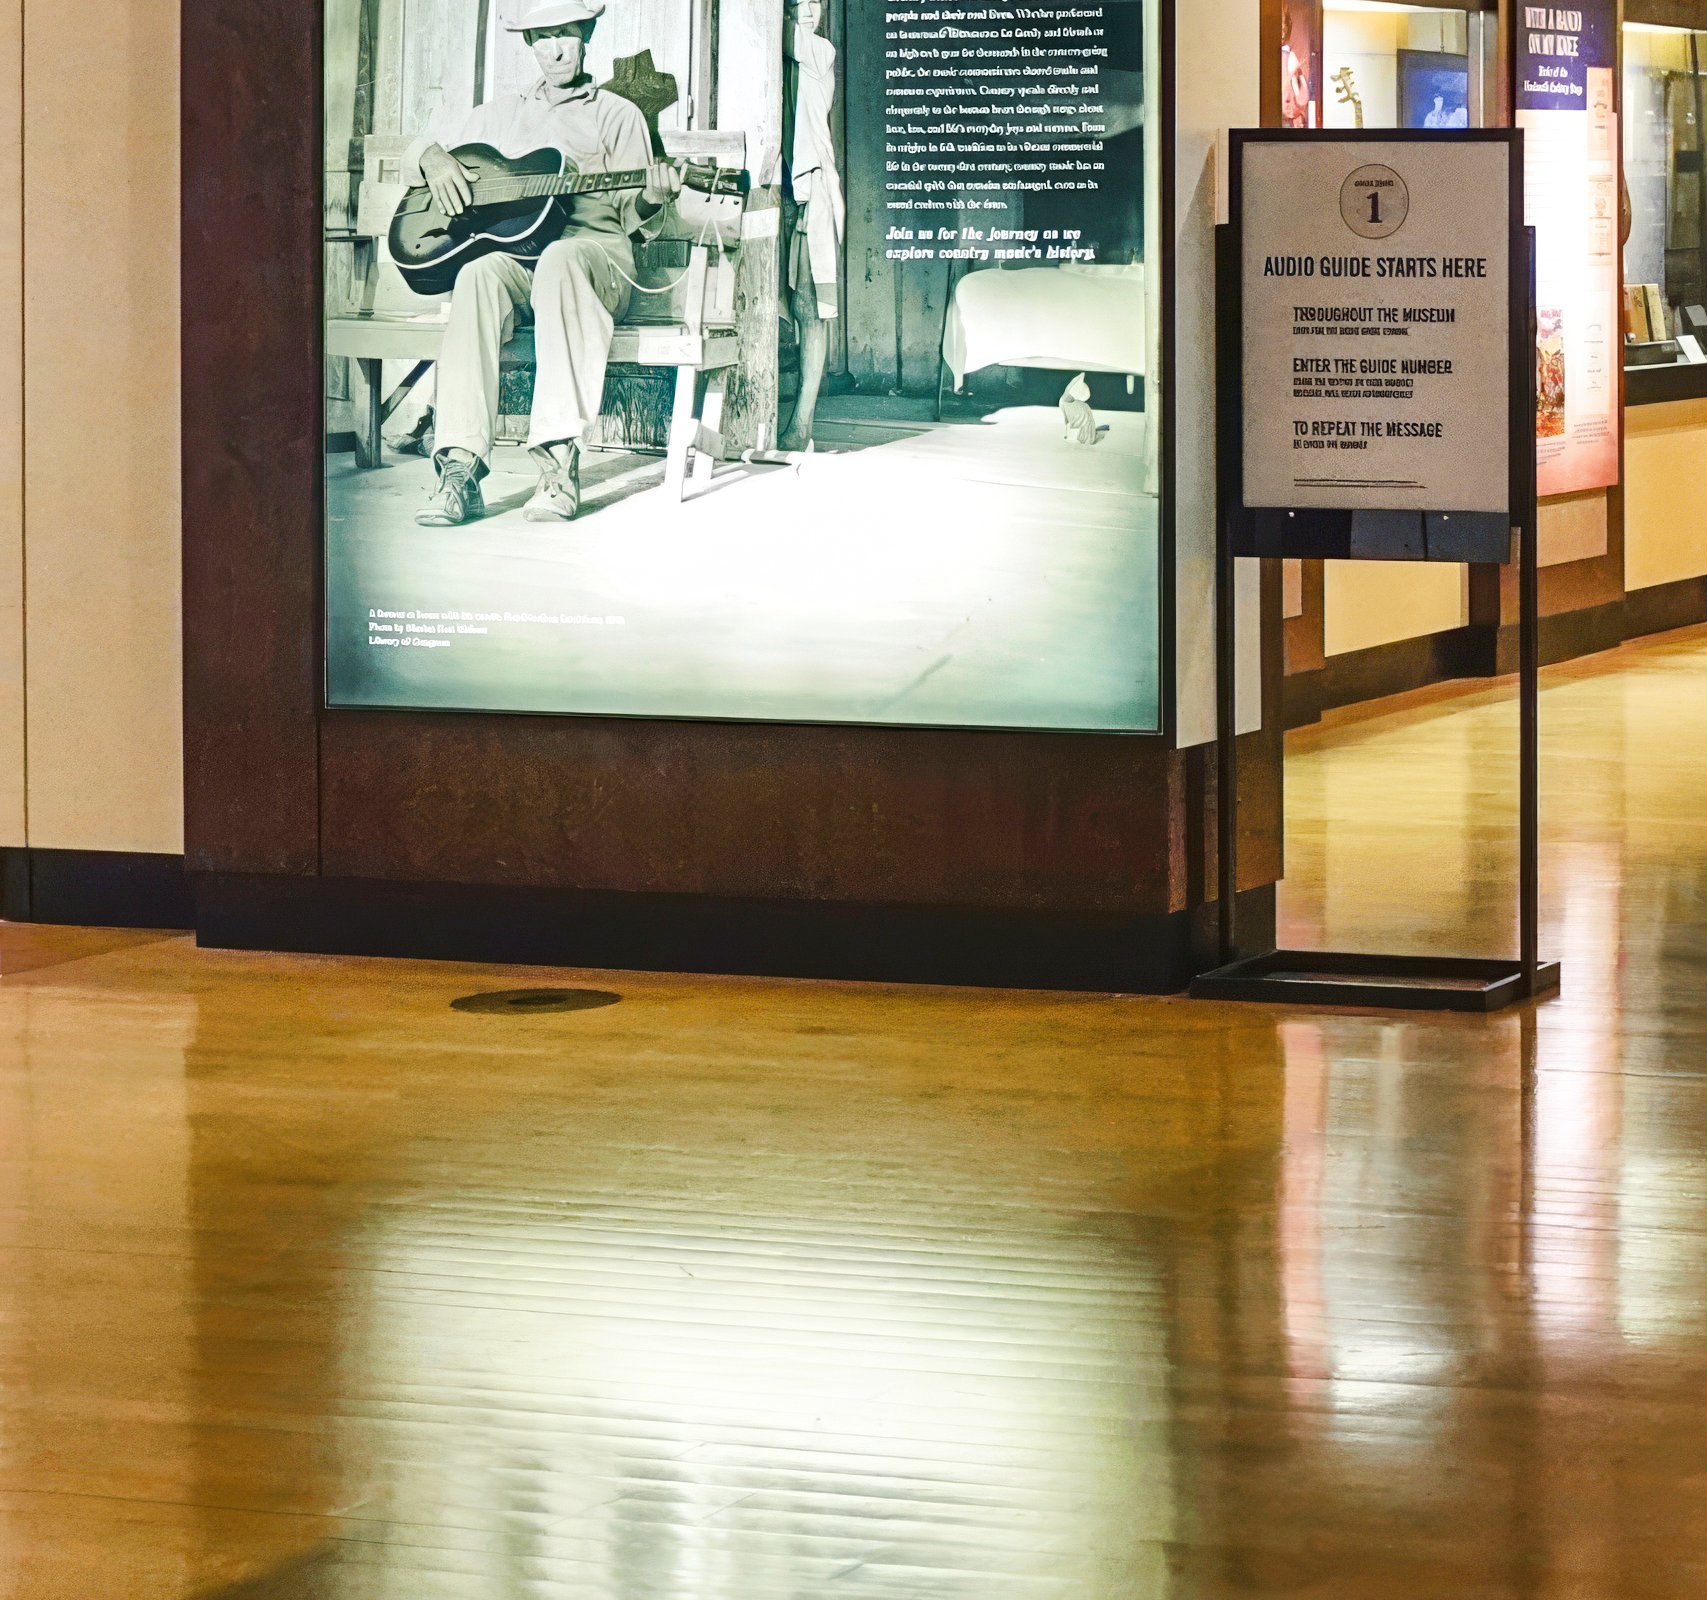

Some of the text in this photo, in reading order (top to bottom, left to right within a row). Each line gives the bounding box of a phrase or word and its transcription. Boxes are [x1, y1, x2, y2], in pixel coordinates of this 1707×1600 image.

[1366, 191, 1383, 224] 1
[886, 226, 913, 240] Join
[938, 228, 957, 240] for
[1263, 256, 1487, 278] AUDIO GUIDE STARTS HERE
[1377, 307, 1399, 322] THE
[1402, 308, 1456, 323] MUSEUM
[1293, 358, 1453, 374] ENTER THE GUIDE NUMBER
[1293, 420, 1443, 438] TO REPEAT THE MESSAGE
